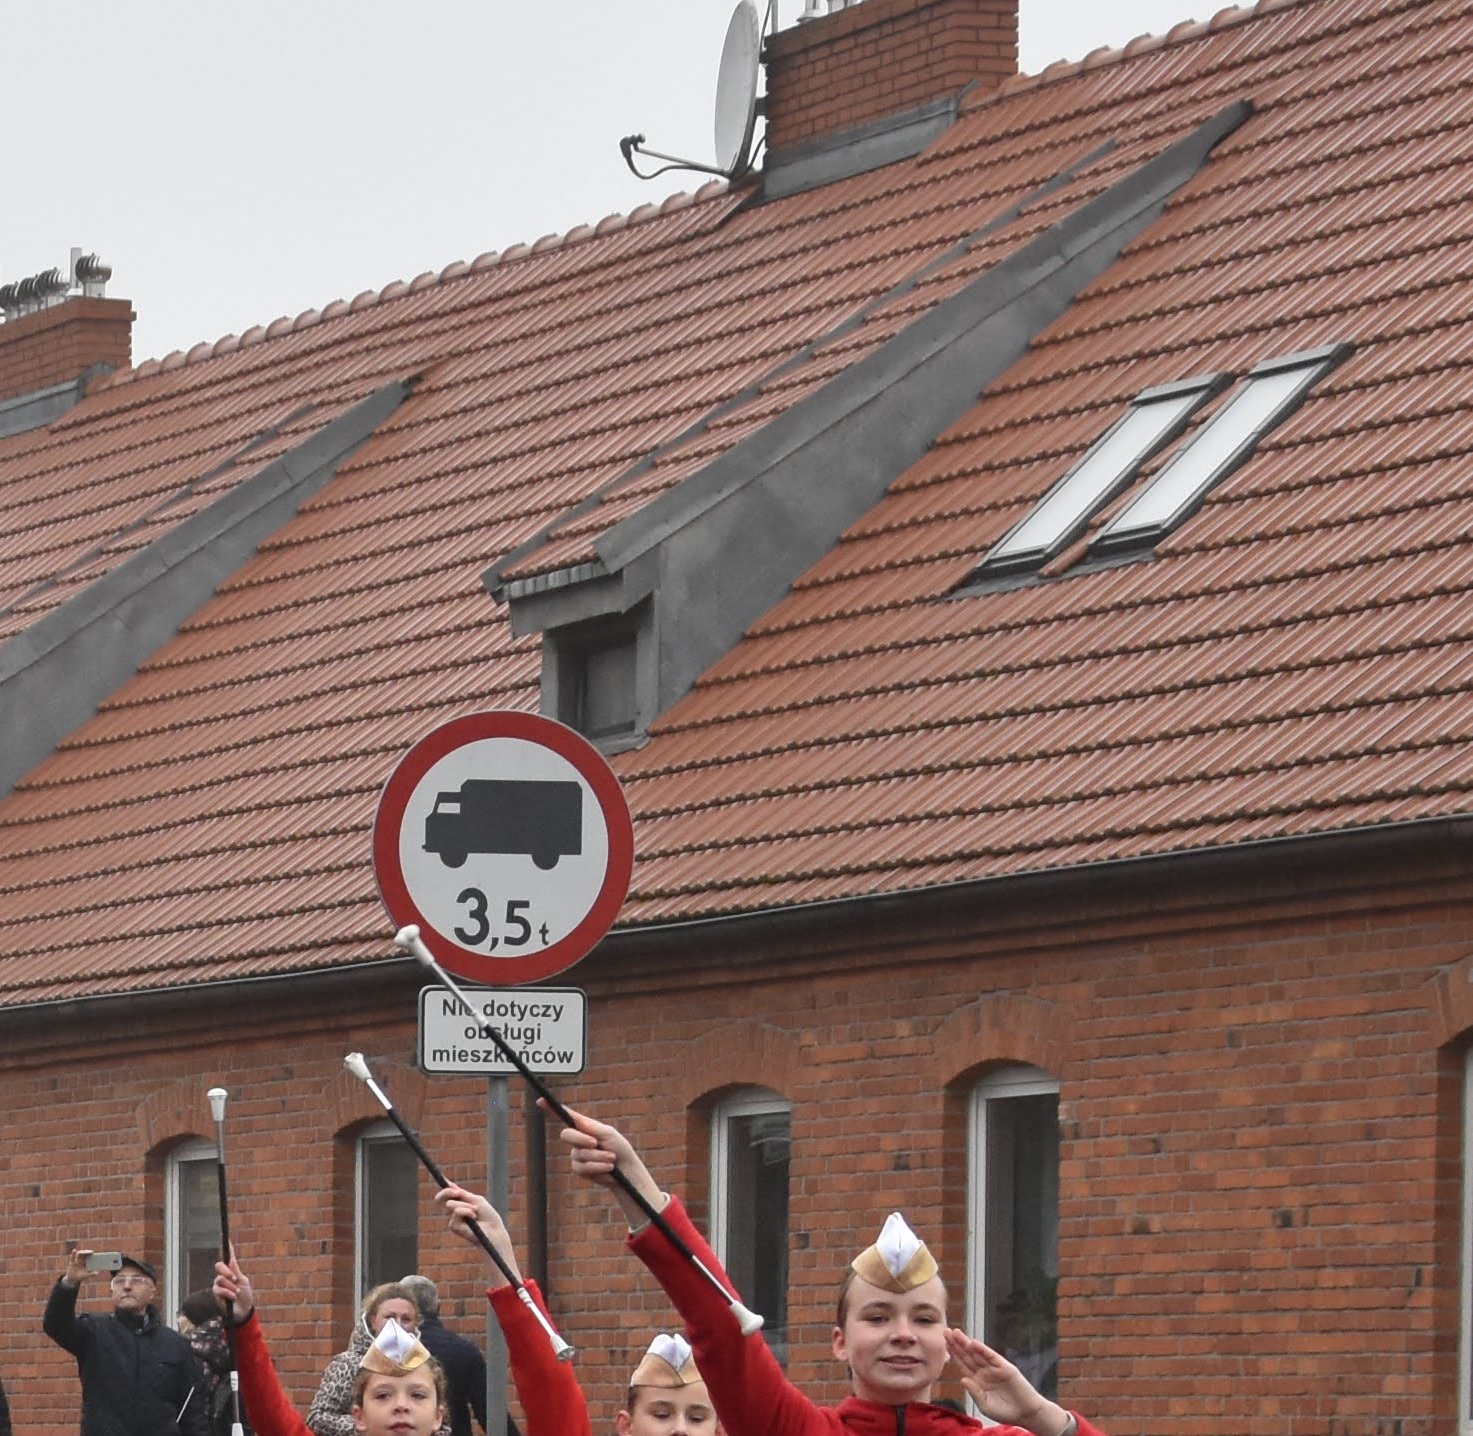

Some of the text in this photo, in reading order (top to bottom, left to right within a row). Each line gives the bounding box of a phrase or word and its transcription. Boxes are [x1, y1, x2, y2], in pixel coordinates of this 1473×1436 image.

[483, 999, 564, 1022] dotyczy
[464, 1022, 541, 1045] obługi
[432, 1045, 574, 1064] mieszkńców
